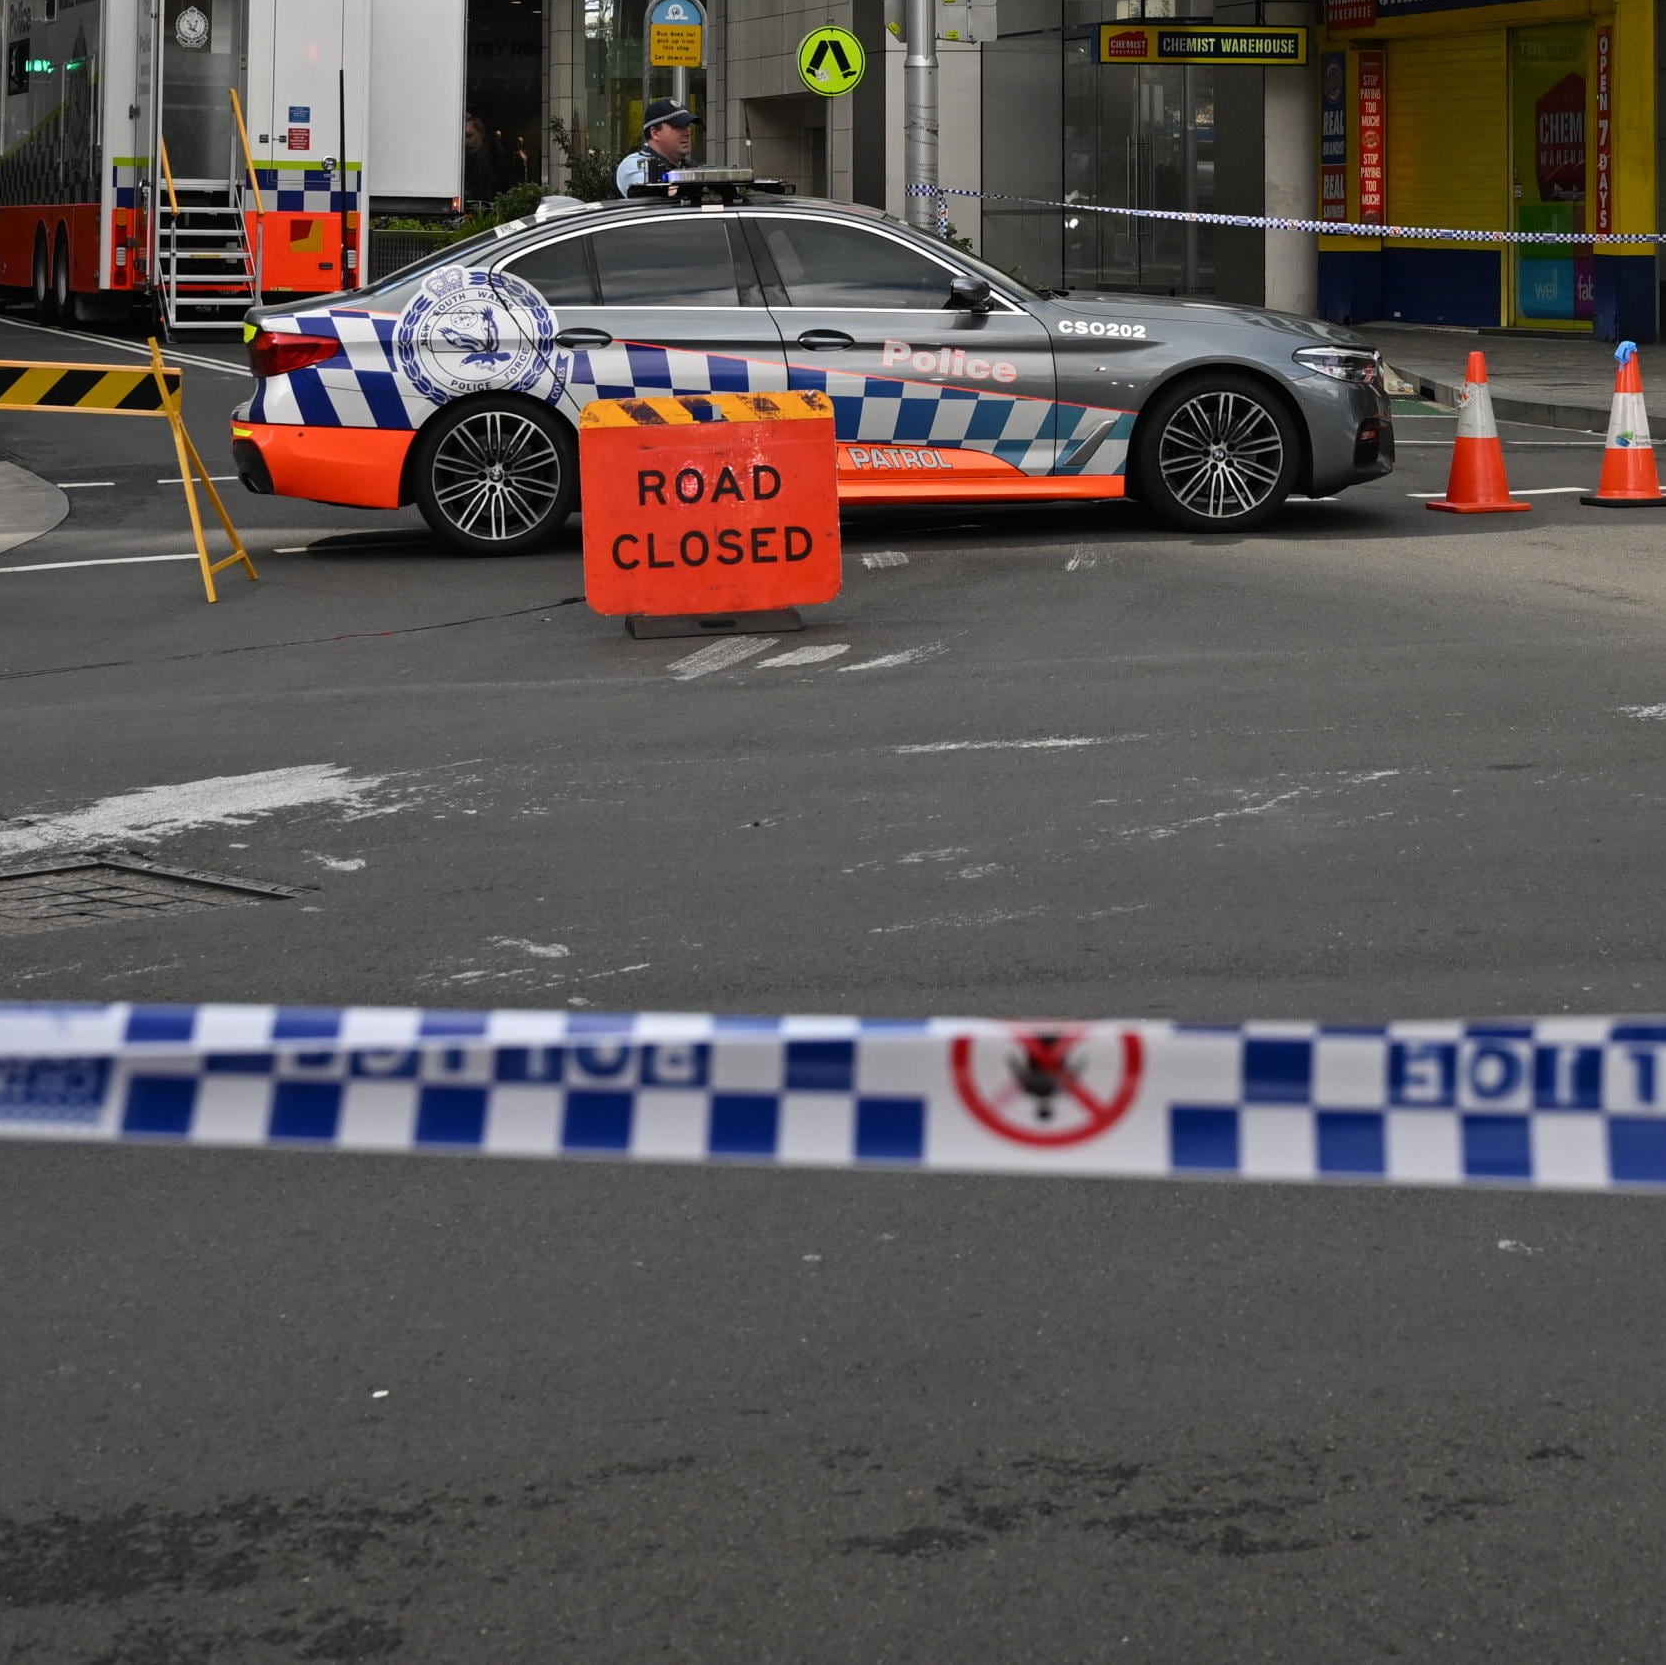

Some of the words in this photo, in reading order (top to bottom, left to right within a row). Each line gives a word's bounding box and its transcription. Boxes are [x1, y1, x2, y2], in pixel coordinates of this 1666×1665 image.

[10, 0, 31, 36] Police
[1328, 5, 1372, 22] WAREHOUSE
[1110, 39, 1146, 49] CHEMIST
[1162, 37, 1217, 53] CHEMIST
[1221, 38, 1296, 54] WAREHOUSE
[1362, 74, 1379, 87] STOP
[1599, 36, 1609, 112] OPEN
[1360, 88, 1381, 100] PAYING
[1365, 101, 1377, 113] TOO
[1323, 110, 1345, 136] REAL
[1598, 118, 1609, 147] 7
[1362, 153, 1379, 165] STOP
[1360, 166, 1381, 179] PAYING
[1323, 173, 1345, 200] REAL
[1365, 180, 1377, 192] TOO
[1599, 153, 1609, 229] DAYS
[1361, 194, 1380, 206] MUCH!
[1534, 267, 1558, 301] well
[419, 322, 431, 346] NEW
[433, 292, 467, 317] SOUTH
[450, 379, 493, 391] POLICE
[504, 347, 530, 381] FORCE
[881, 338, 1019, 383] Police
[849, 447, 954, 470] PATROL
[637, 465, 782, 507] ROAD
[611, 526, 814, 571] CLOSED
